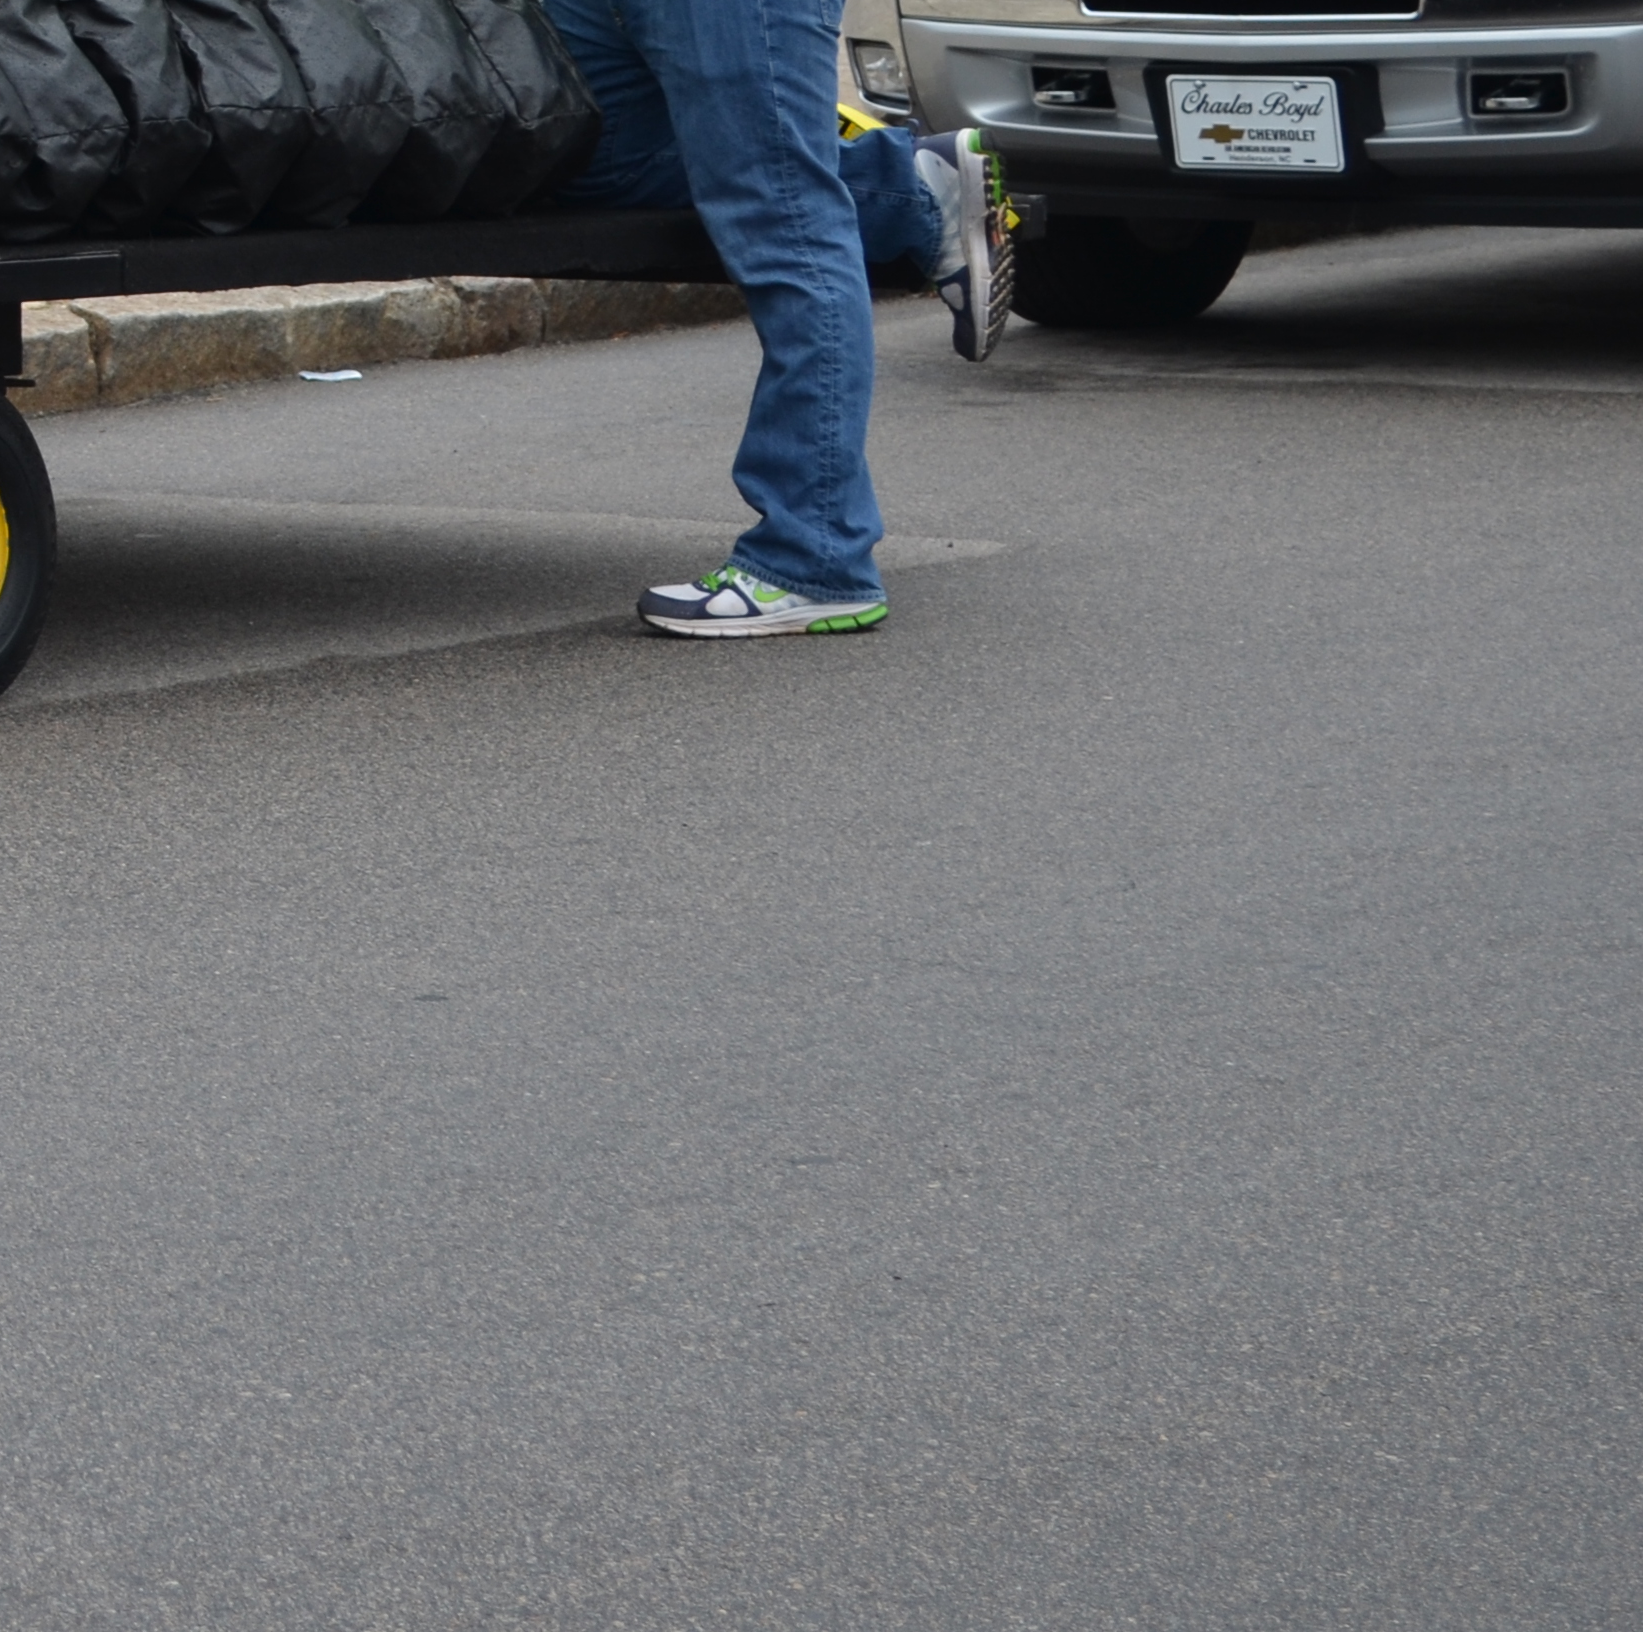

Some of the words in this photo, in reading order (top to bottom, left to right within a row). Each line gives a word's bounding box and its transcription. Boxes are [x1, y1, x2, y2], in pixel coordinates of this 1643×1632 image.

[1181, 89, 1253, 115] Charles
[1258, 91, 1325, 124] Boyd
[1247, 128, 1317, 142] CHEVROLET
